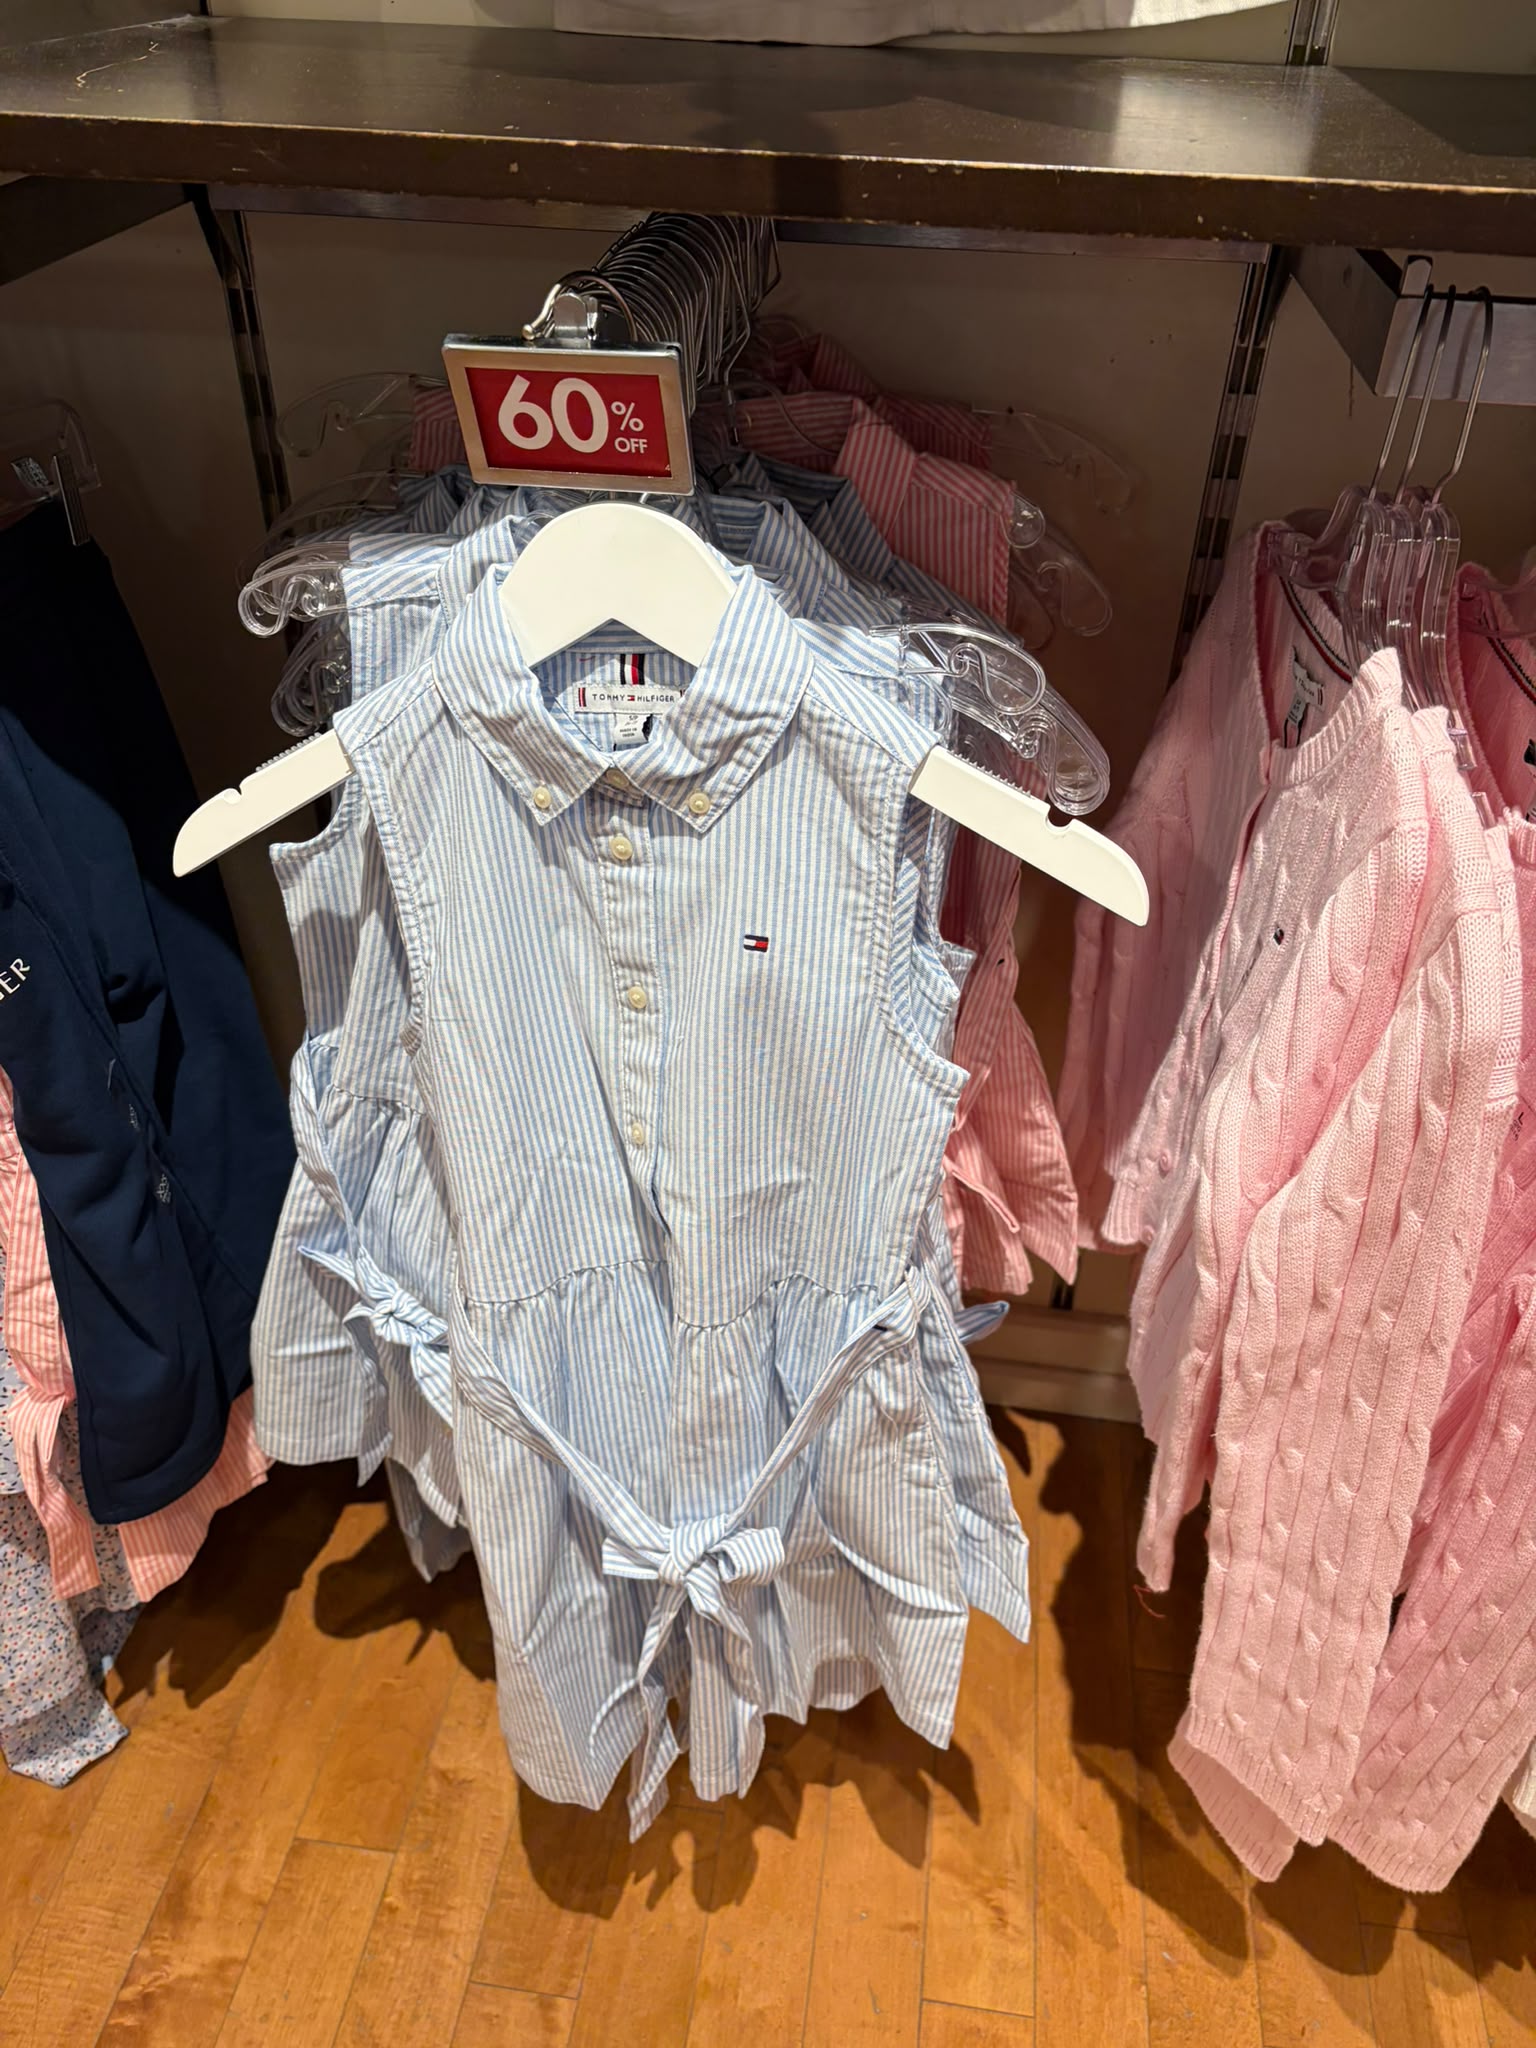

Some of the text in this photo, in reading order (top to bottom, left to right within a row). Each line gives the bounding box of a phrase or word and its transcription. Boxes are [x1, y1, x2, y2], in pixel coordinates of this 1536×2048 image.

[614, 437, 648, 454] OFF
[592, 693, 675, 703] TOMMY HILFIGER
[0, 958, 31, 1000] ER
